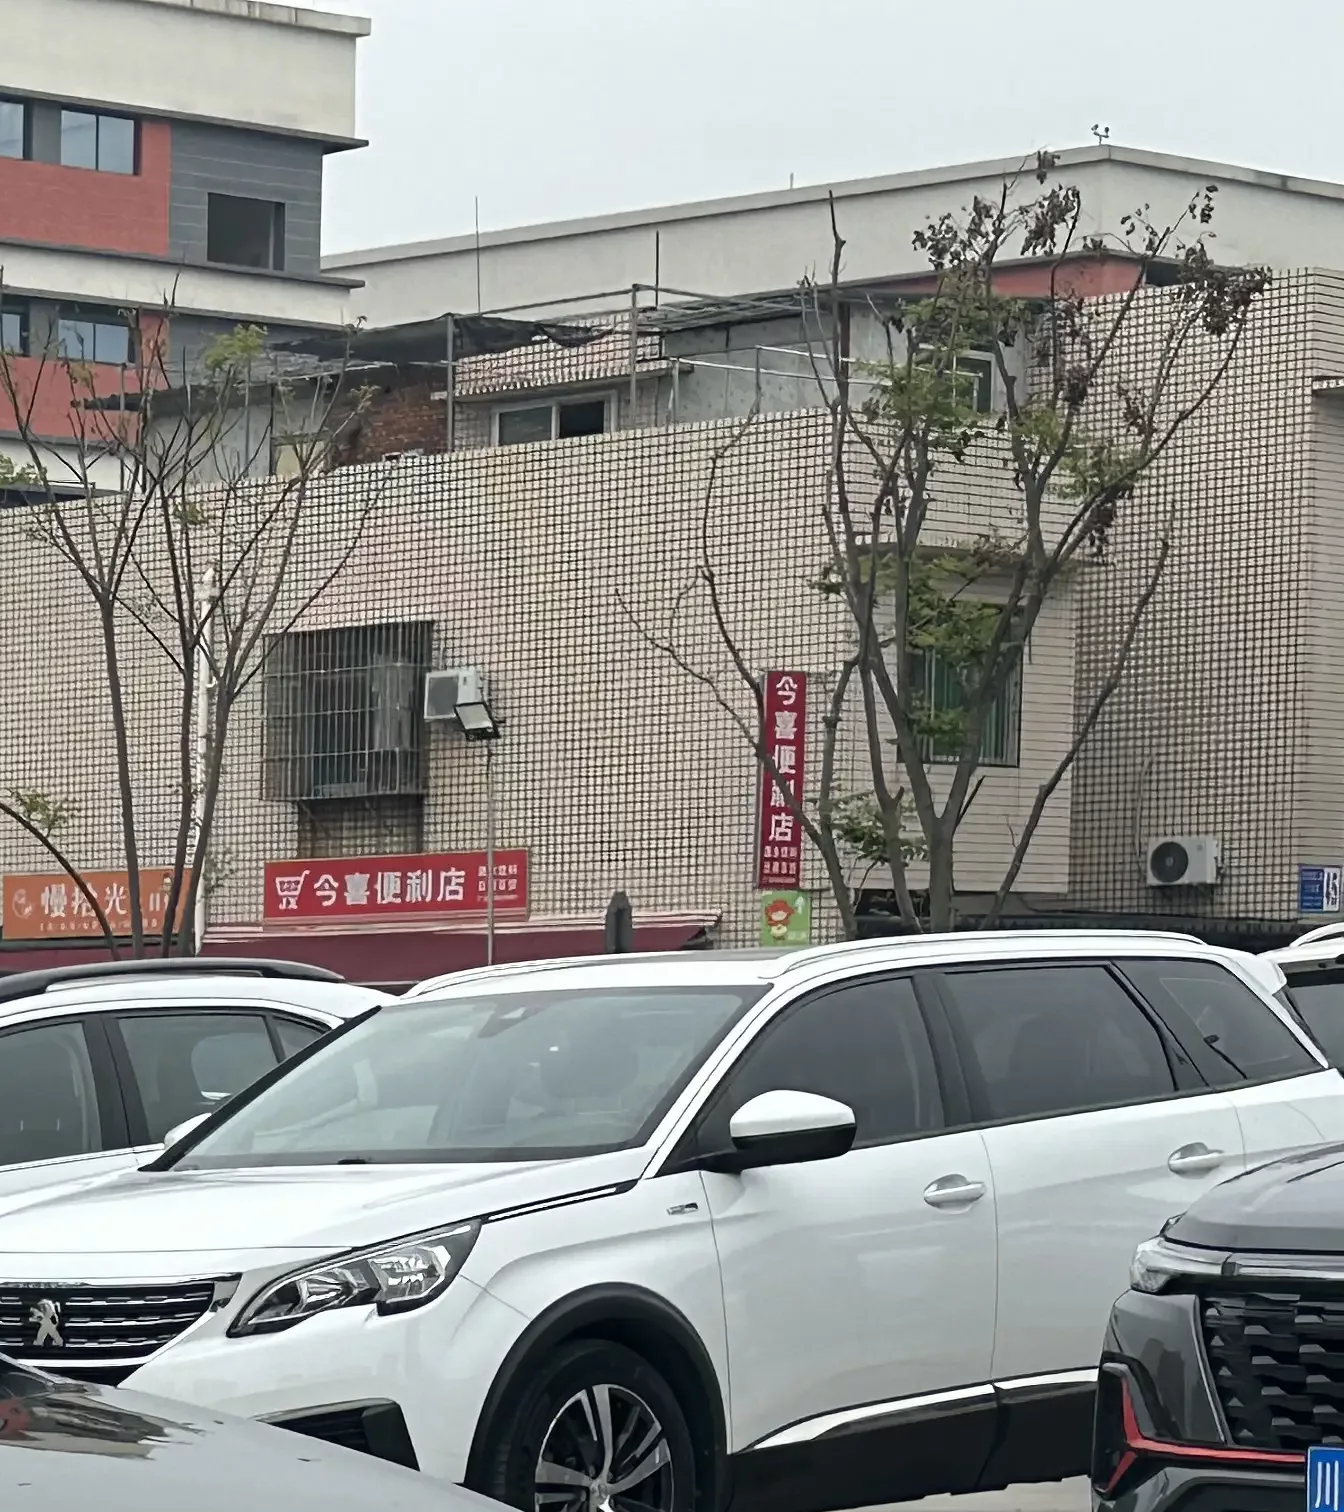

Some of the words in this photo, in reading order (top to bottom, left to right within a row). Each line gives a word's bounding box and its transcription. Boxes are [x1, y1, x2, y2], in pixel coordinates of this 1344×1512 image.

[313, 867, 466, 907] 今喜便利店
